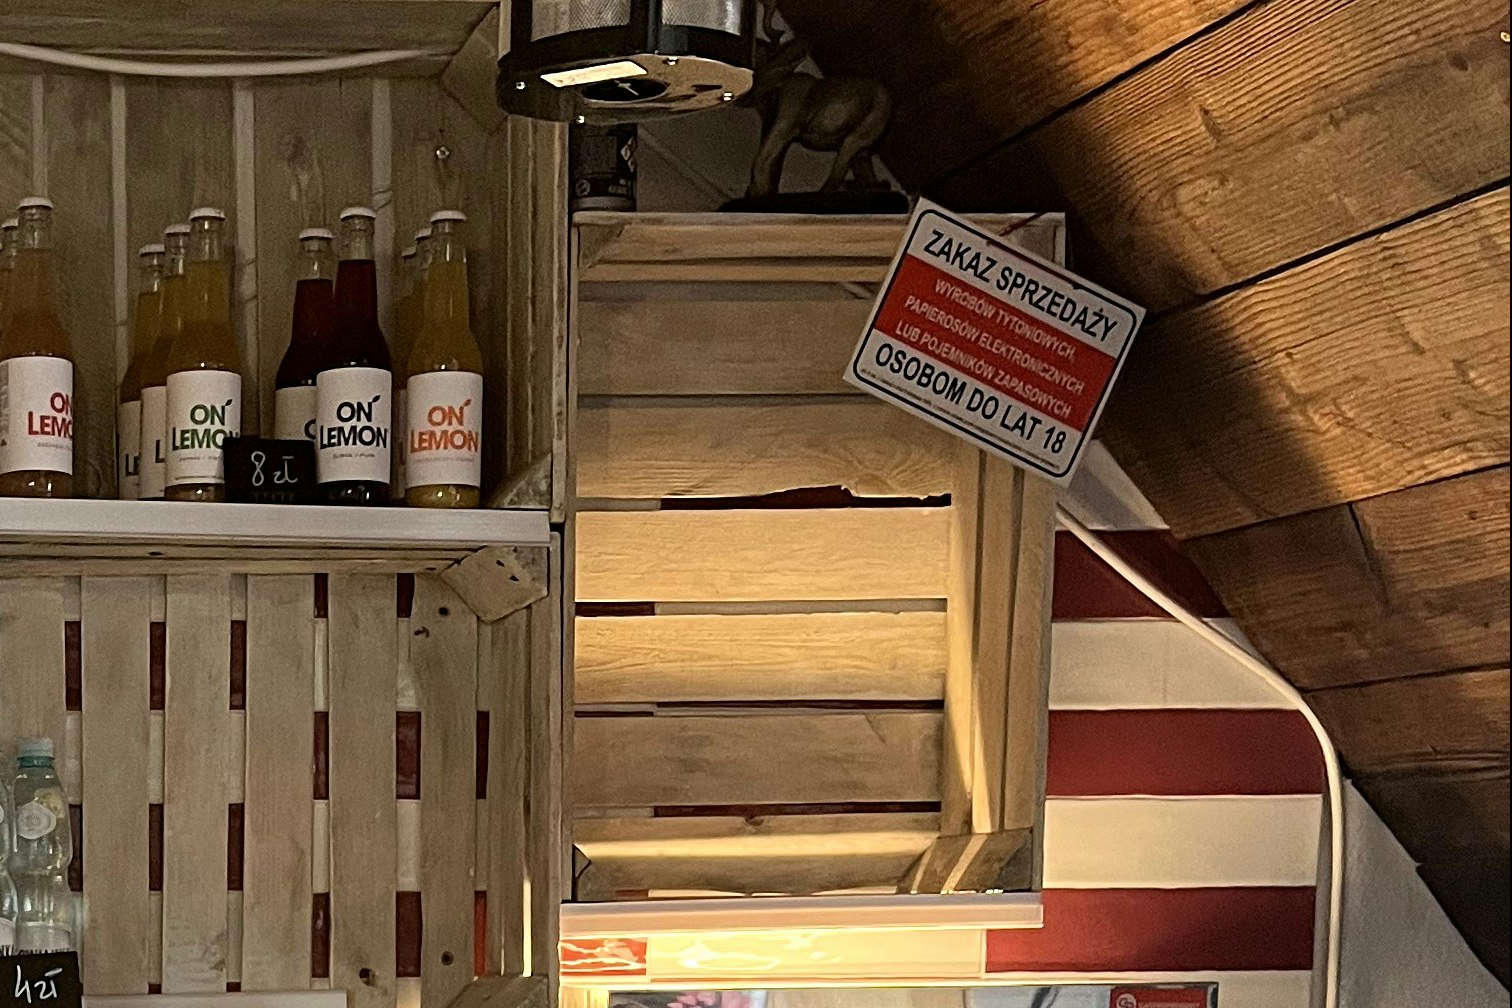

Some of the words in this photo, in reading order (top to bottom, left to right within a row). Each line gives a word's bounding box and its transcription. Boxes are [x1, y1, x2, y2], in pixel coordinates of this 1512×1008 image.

[924, 229, 999, 283] ZAKAZ
[996, 266, 1118, 342] SPRZEDAŻY
[935, 279, 996, 318] WYROBÓW
[905, 295, 979, 342] PAPIEROSÓW
[978, 332, 1086, 395] ELEKTRONICZNYCH
[895, 320, 921, 342] LUB
[920, 333, 996, 380] POJEMNIKÓW
[994, 370, 1072, 418] ZAPASOWYCH
[190, 404, 226, 426] ON
[336, 401, 373, 423] ON
[876, 343, 968, 405] OSOBOM
[966, 387, 1000, 420] DO
[999, 404, 1043, 441] LAT
[1044, 426, 1067, 454] 18
[428, 406, 465, 427] ON
[320, 425, 388, 450] LEMON
[410, 429, 479, 454] LEMON
[251, 451, 266, 486] 8
